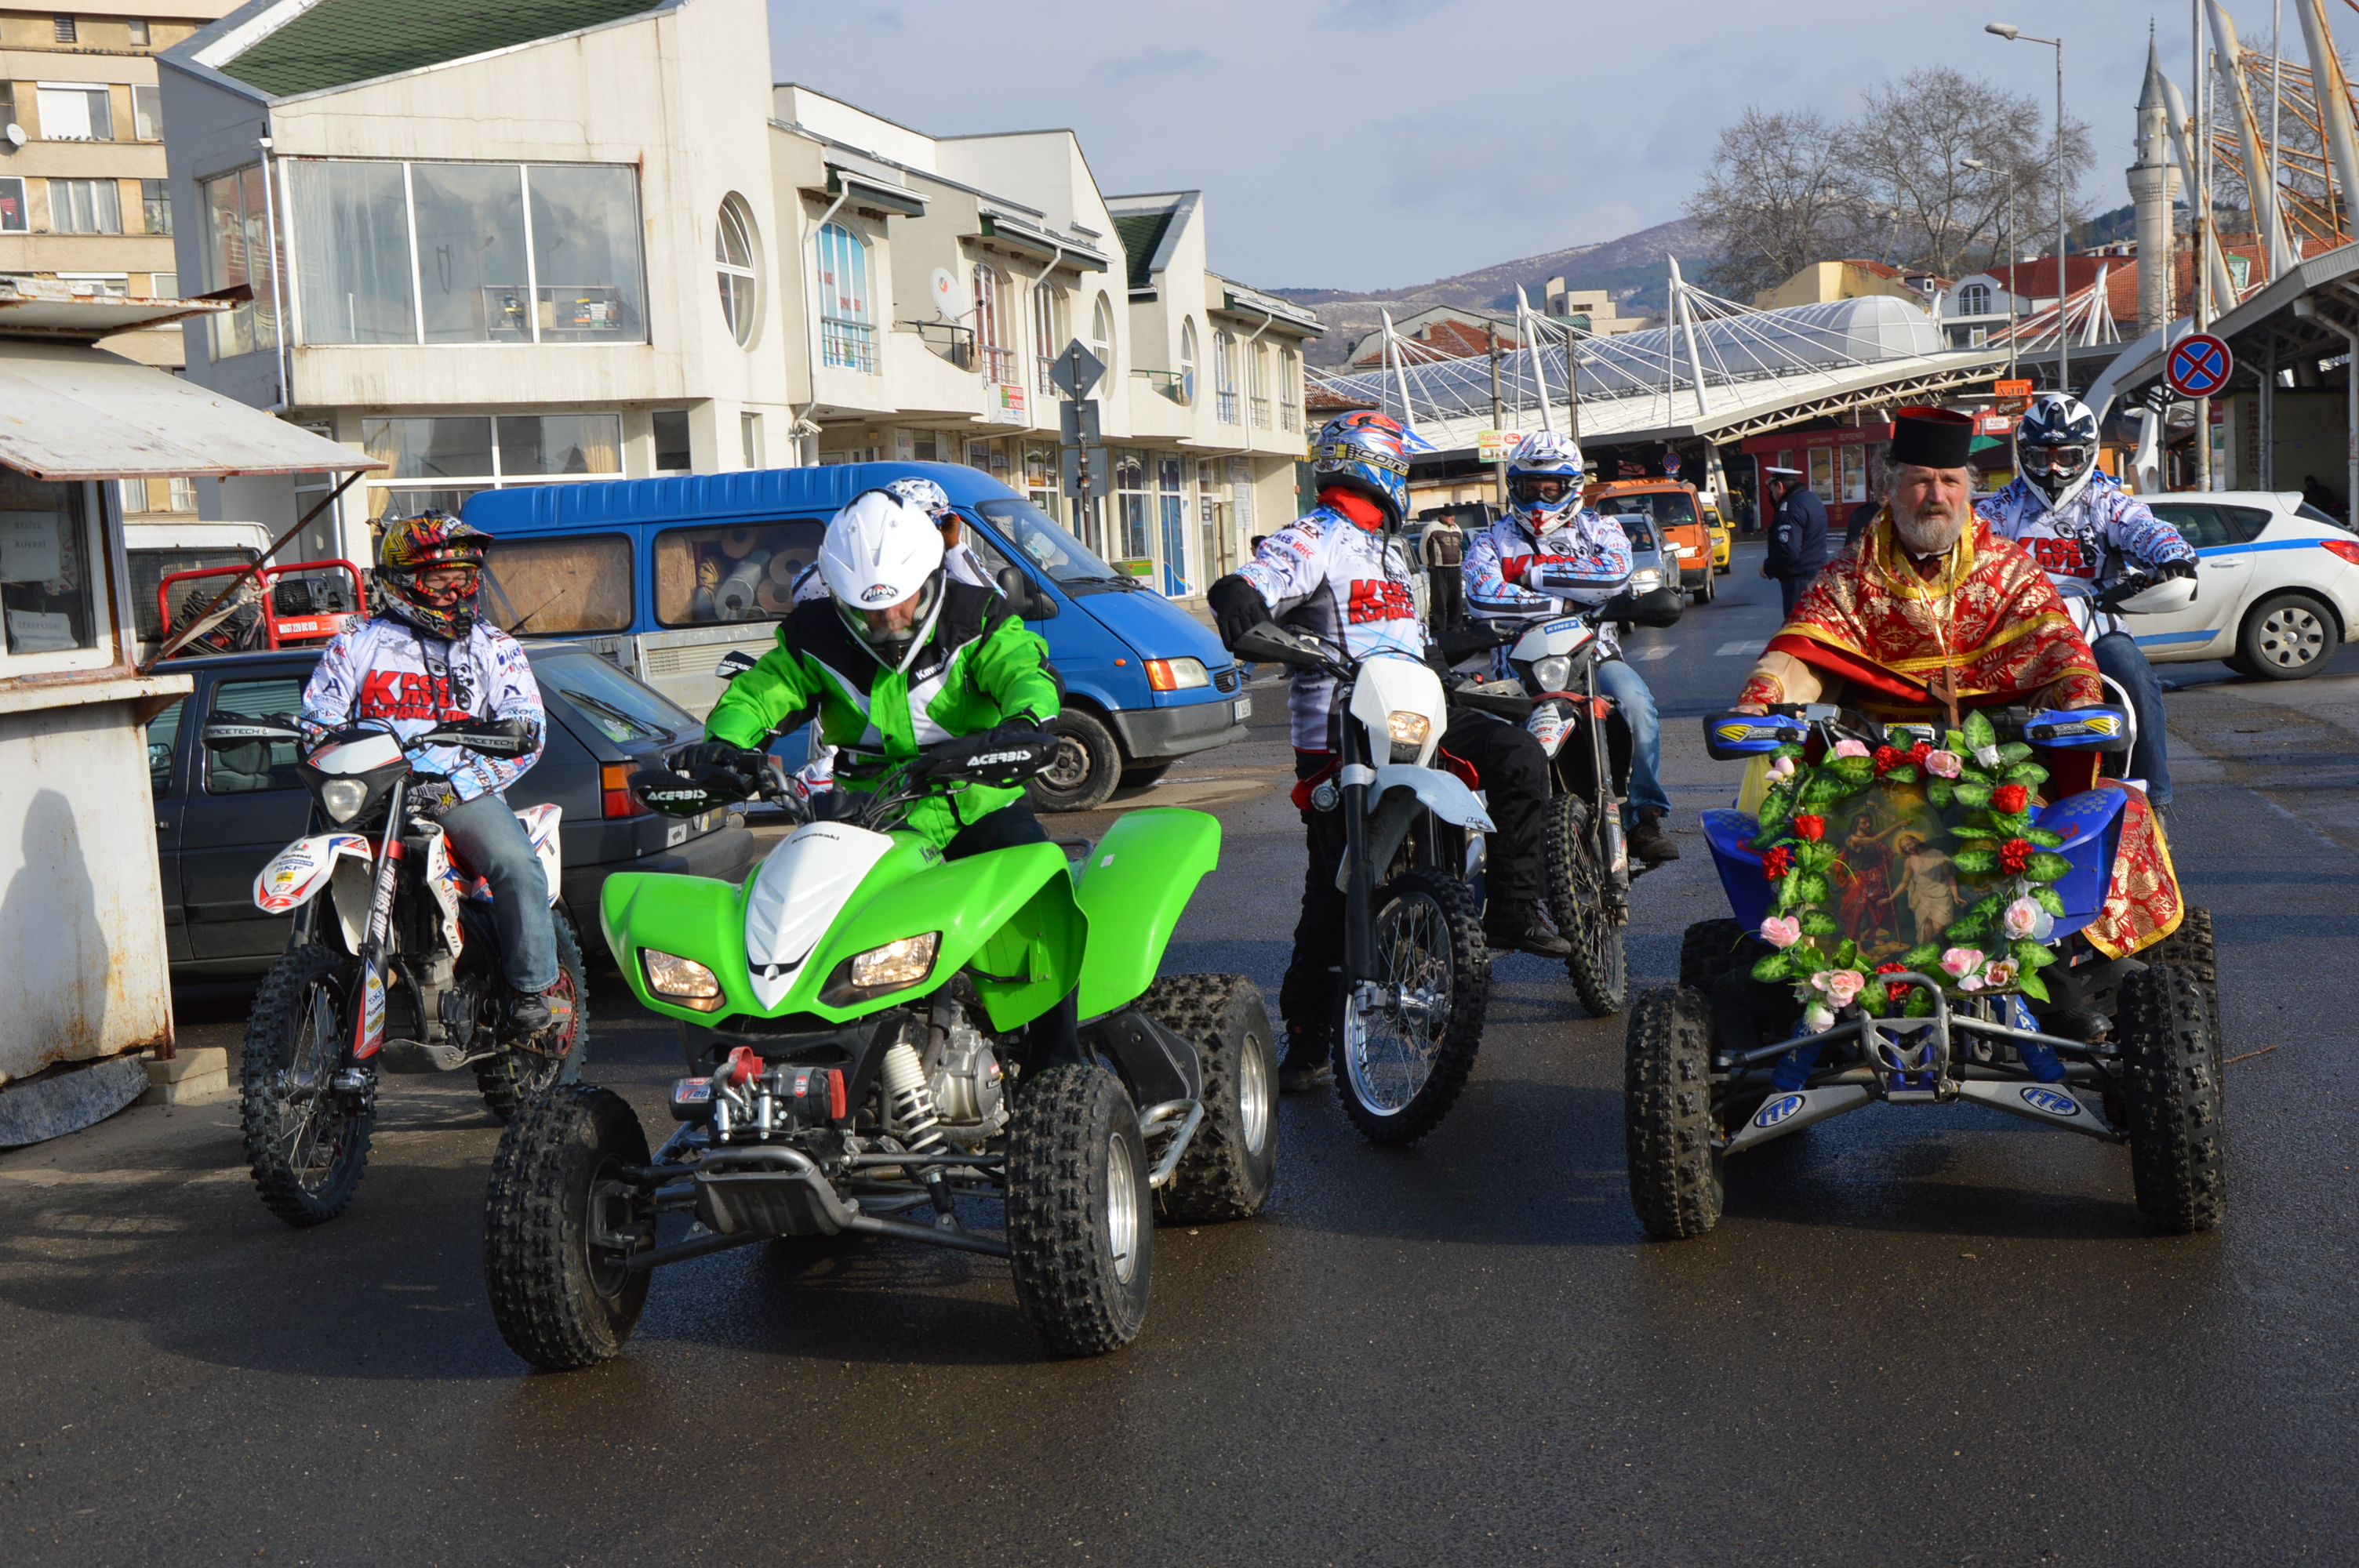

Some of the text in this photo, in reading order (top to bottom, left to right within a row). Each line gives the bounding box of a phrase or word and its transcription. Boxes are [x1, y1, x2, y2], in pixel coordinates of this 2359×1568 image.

[863, 585, 897, 601] Airoh
[463, 736, 514, 746] RACETECH
[966, 750, 1032, 767] ACERBIS
[647, 789, 707, 800] ACERBIS
[791, 833, 840, 844] Kawasaki
[2026, 1088, 2074, 1112] ITP
[1761, 1095, 1797, 1126] ITP
